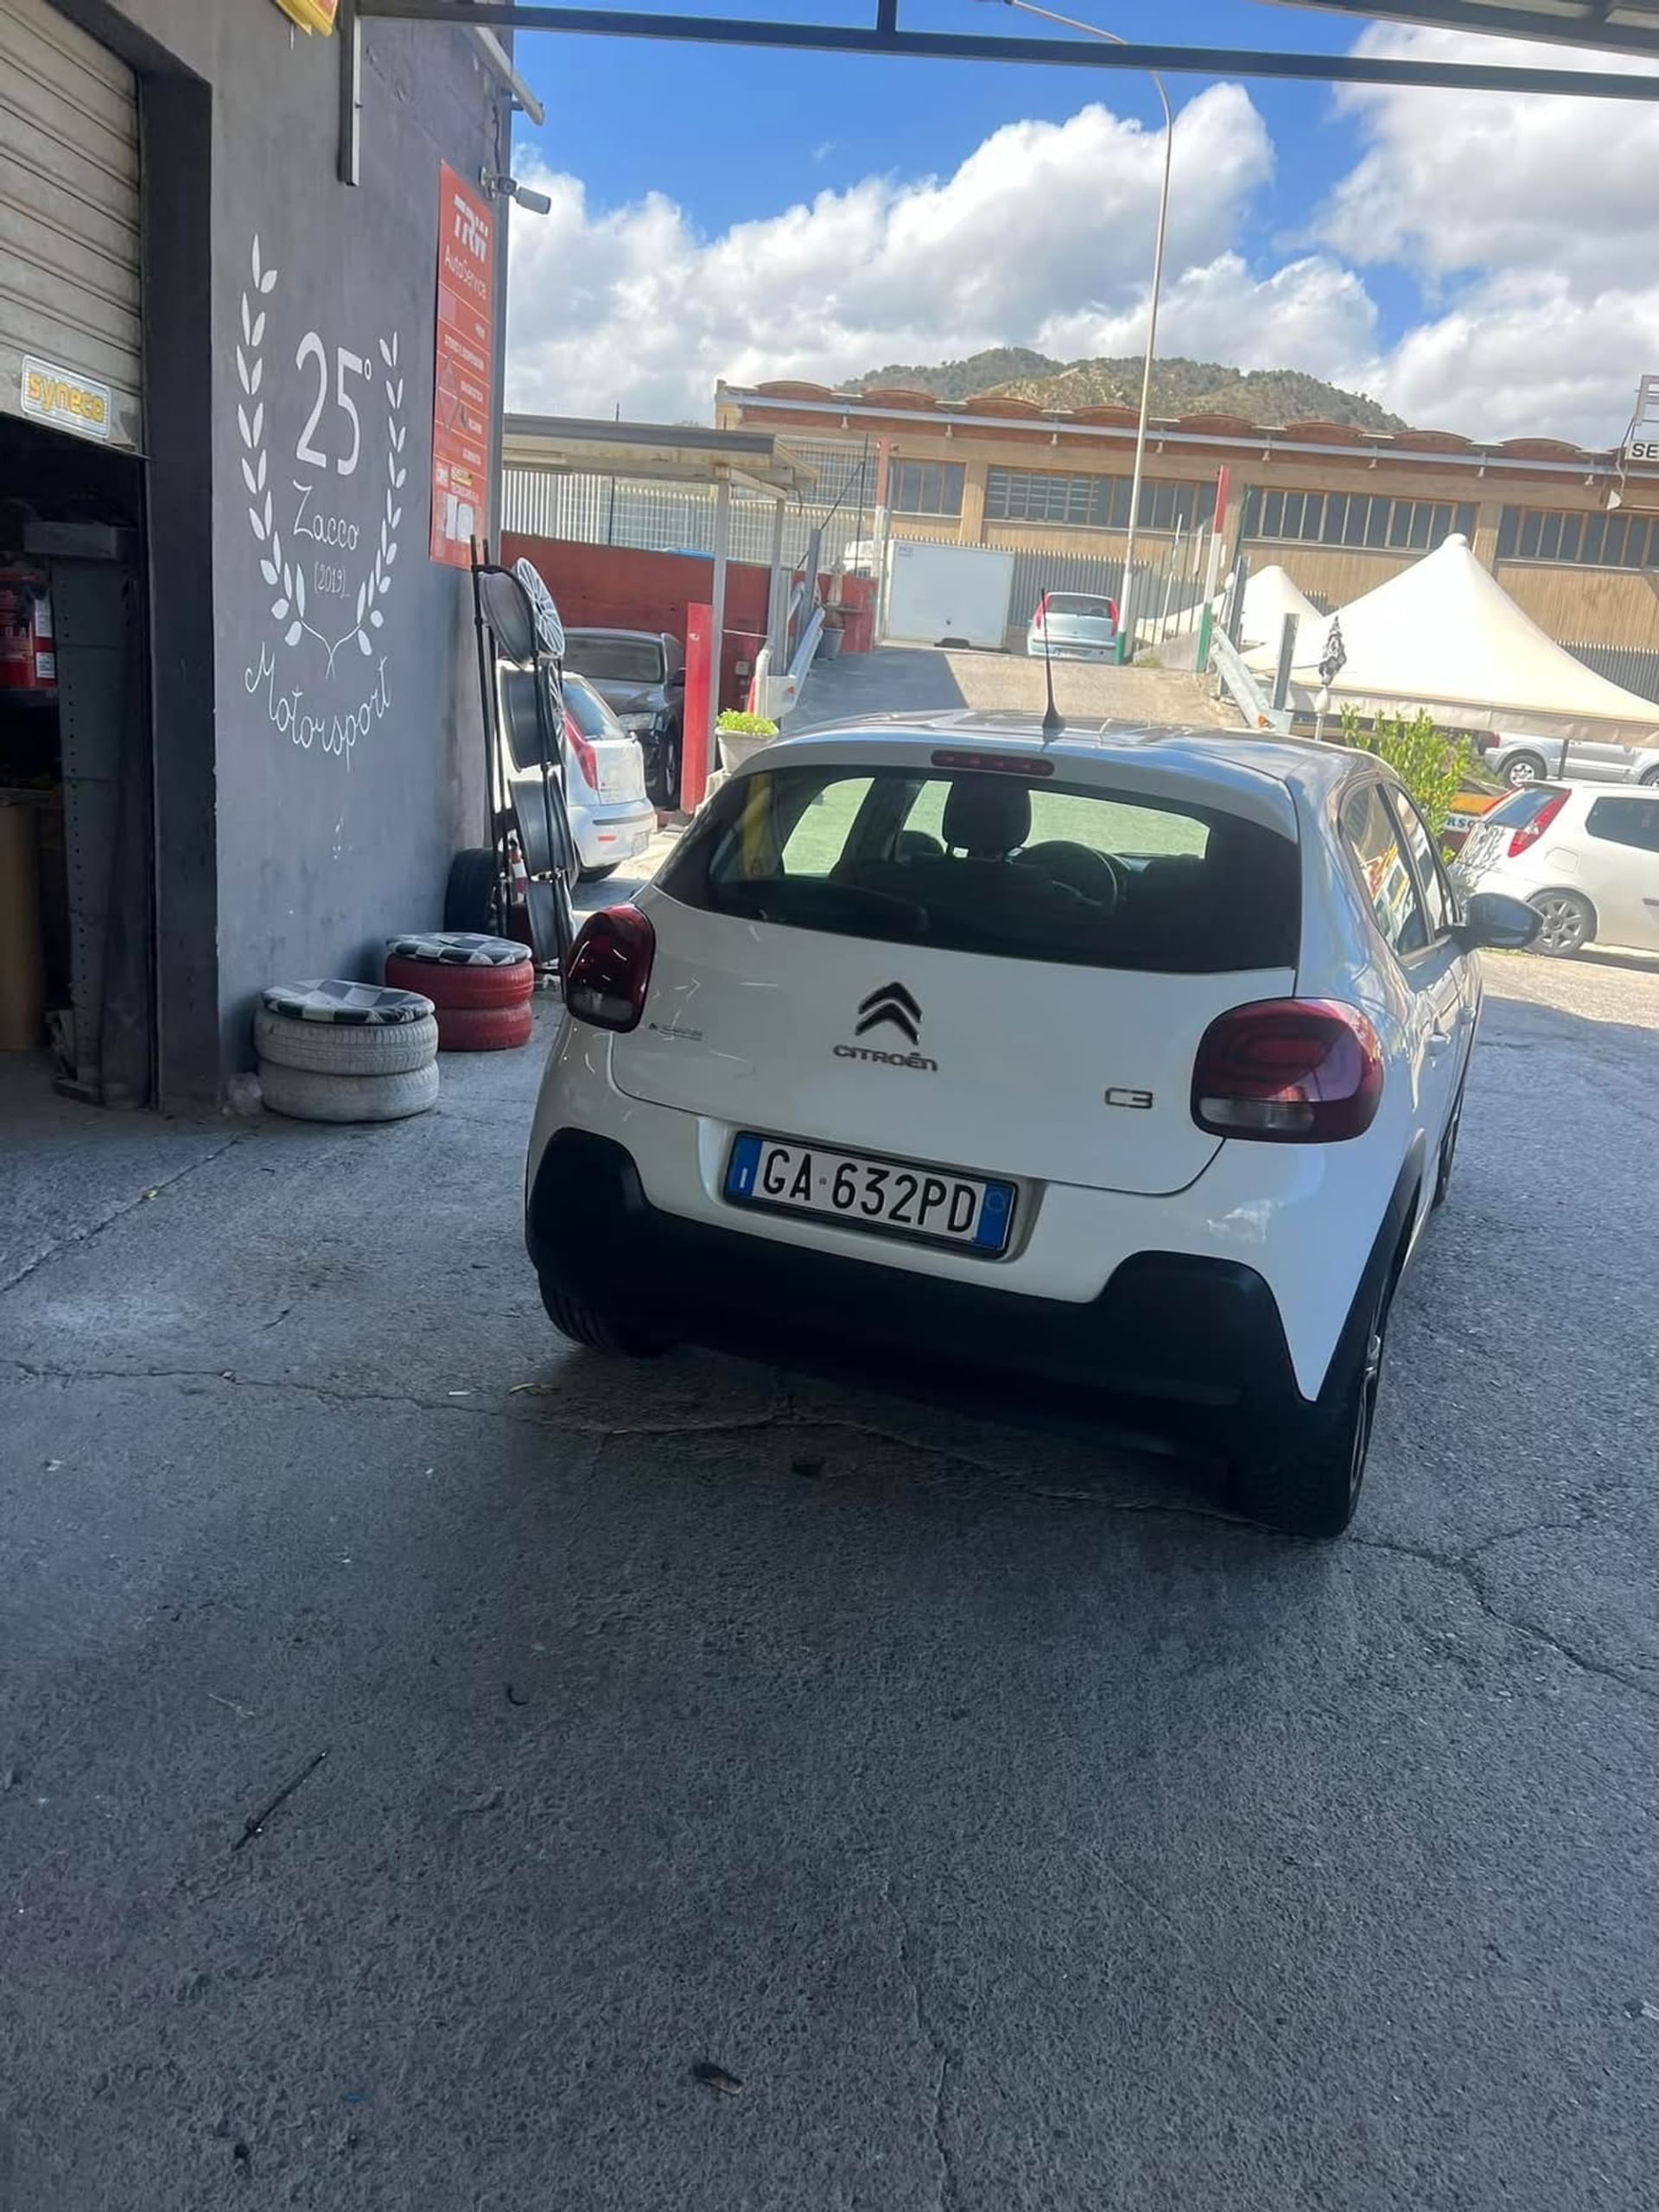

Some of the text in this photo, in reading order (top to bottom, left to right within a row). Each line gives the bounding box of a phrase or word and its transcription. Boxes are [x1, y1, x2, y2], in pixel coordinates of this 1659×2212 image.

[454, 193, 489, 263] TRW
[292, 479, 359, 550] Zacco
[245, 641, 391, 772] Motorsport
[1105, 1087, 1153, 1109] C3
